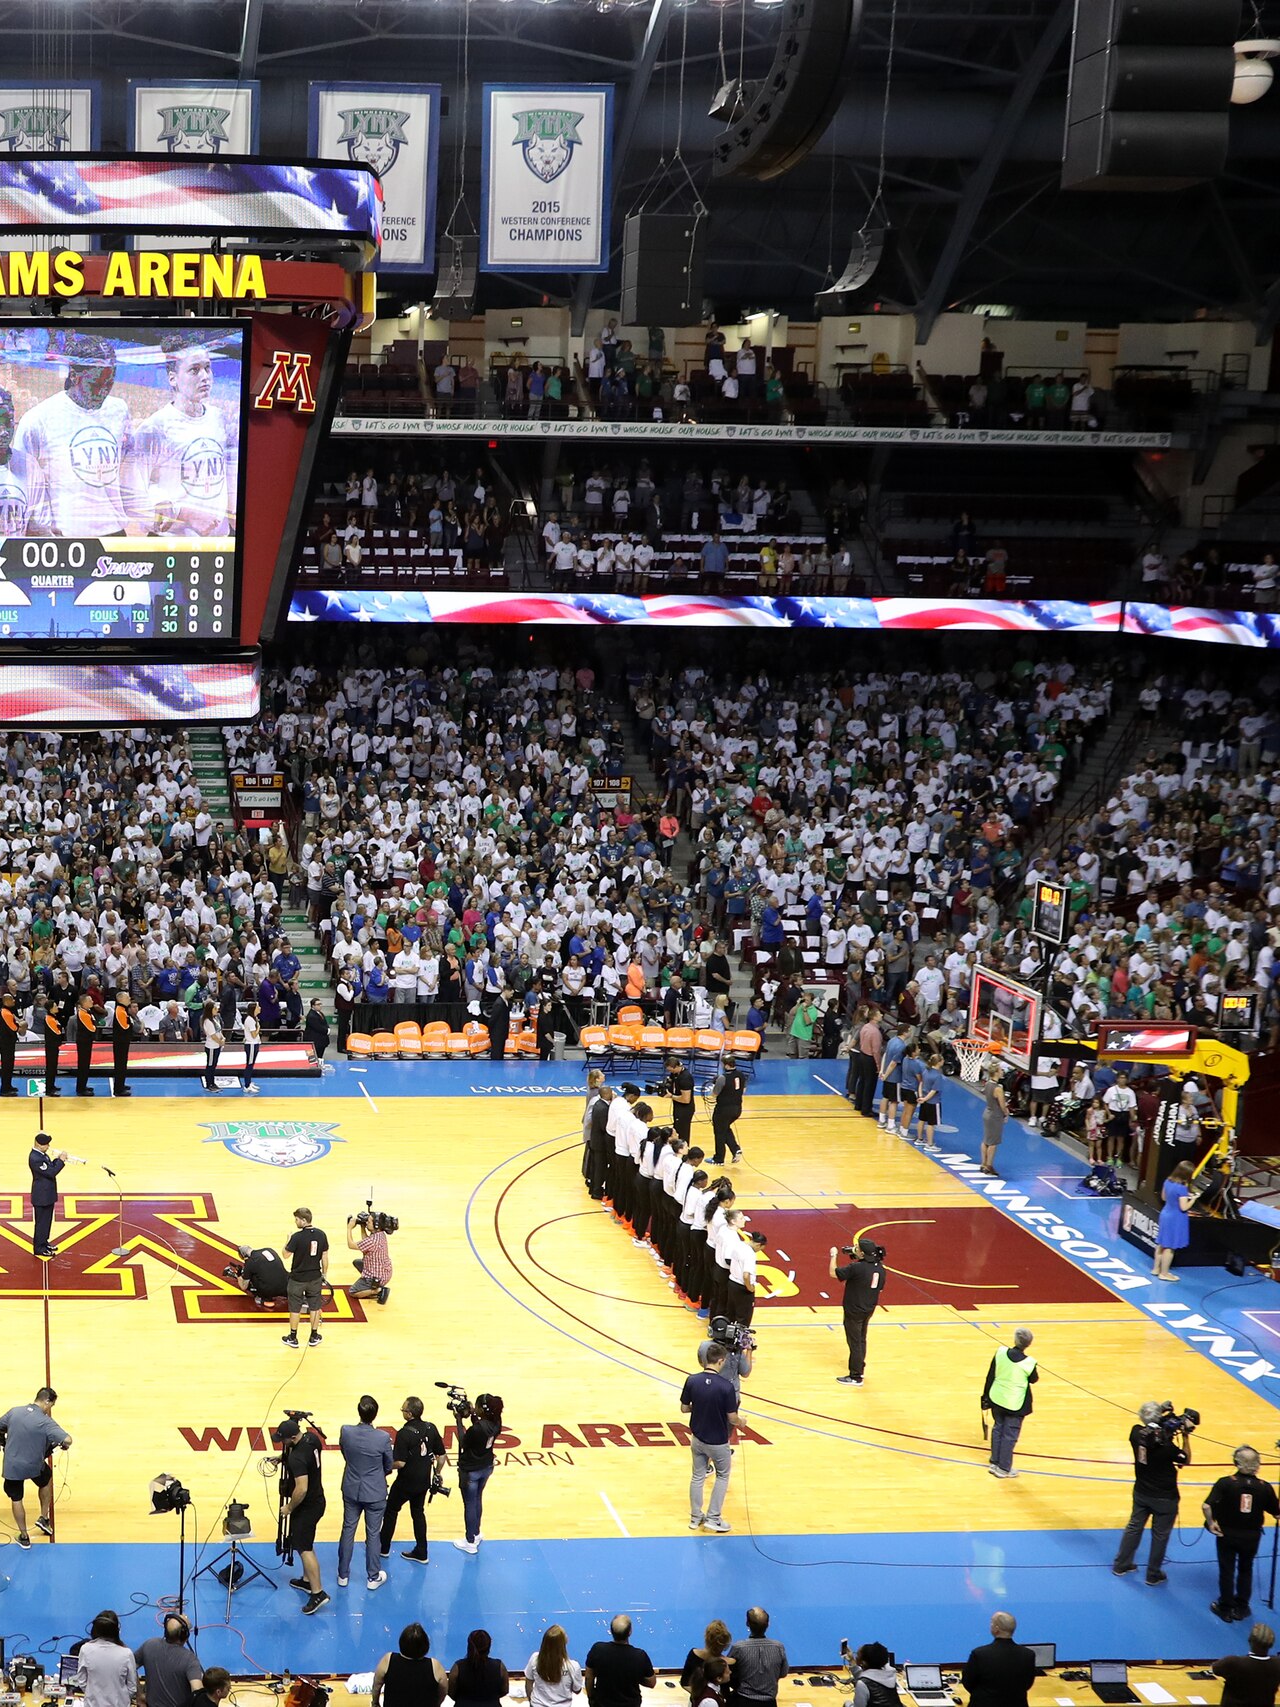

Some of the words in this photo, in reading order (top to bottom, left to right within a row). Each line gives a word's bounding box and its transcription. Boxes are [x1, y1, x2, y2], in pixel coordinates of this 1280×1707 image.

[2, 110, 69, 138] LYNX
[160, 109, 227, 137] LYNX
[342, 113, 408, 140] LYNX
[516, 113, 582, 141] LYNX
[532, 201, 560, 214] 2015
[501, 217, 538, 226] WESTERN
[540, 217, 591, 226] CONFERENCE
[509, 228, 583, 242] CHAMPIONS
[103, 251, 267, 299] ARENA
[255, 351, 316, 412] M
[22, 542, 86, 568] 00.0
[166, 556, 175, 568] 0
[190, 556, 200, 568] 0
[214, 556, 224, 568] 0
[91, 556, 154, 578] SPARKS
[31, 575, 74, 587] QUARTER
[167, 572, 173, 584] 1
[190, 573, 199, 585] 0
[214, 573, 223, 585] 0
[47, 591, 56, 607] 1
[113, 584, 125, 601] 0
[165, 589, 174, 601] 3
[189, 589, 199, 601] 0
[213, 589, 223, 601] 0
[90, 610, 118, 621] FOULS
[132, 610, 149, 621] TOL
[162, 605, 178, 617] 12
[189, 605, 198, 617] 0
[213, 605, 222, 617] 0
[102, 624, 111, 634] 0
[136, 623, 145, 633] 3
[161, 621, 177, 633] 30
[188, 621, 198, 633] 0
[212, 621, 222, 633] 0
[261, 777, 272, 785] 107
[212, 1122, 333, 1141] LYNX
[1163, 1103, 1180, 1147] verizon
[932, 1153, 1153, 1291] MINNESOTA
[1142, 1302, 1280, 1382] LYNX
